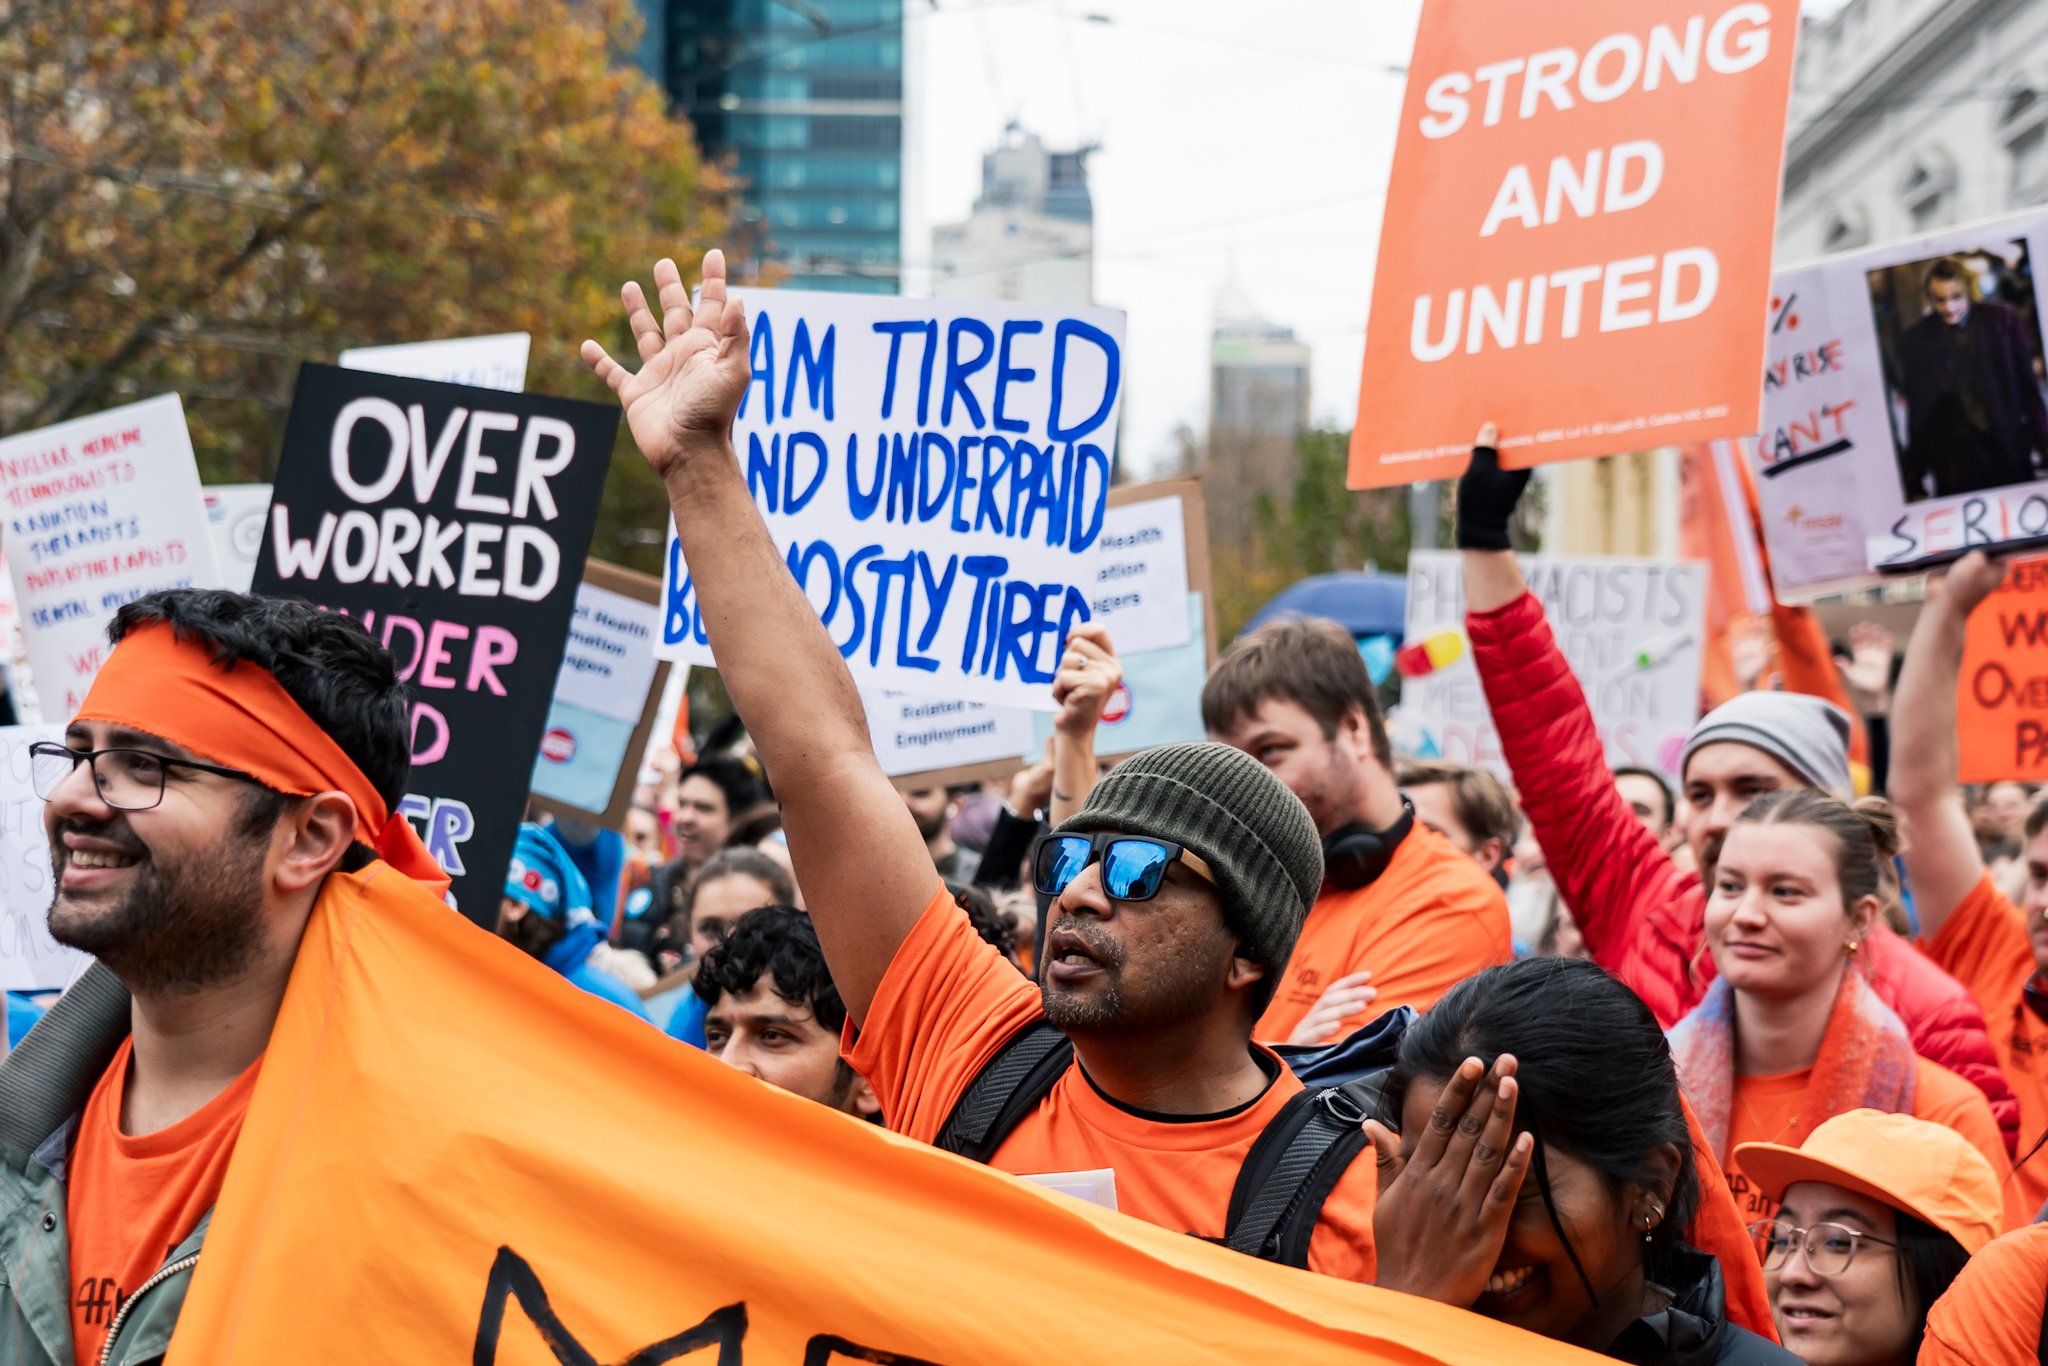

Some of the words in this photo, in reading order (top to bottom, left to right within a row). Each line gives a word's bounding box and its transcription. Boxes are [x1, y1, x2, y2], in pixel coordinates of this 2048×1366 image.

[1419, 2, 1771, 139] STRONG
[1479, 140, 1664, 237] AND
[1410, 246, 1719, 362] UNITED
[738, 310, 835, 425] AM
[873, 317, 1121, 441] TIRED
[1765, 358, 1788, 391] AY
[1793, 338, 1844, 381] RISE
[82, 426, 145, 457] MEDICINE
[330, 397, 576, 520] OVER
[1758, 400, 1856, 463] CAN'T
[748, 431, 829, 515] ND
[847, 432, 1110, 554] UNDERPAID
[28, 515, 141, 562] THERAPISTS
[272, 503, 560, 601] WORKED
[1100, 526, 1163, 553] Health
[1097, 561, 1147, 583] ation
[31, 597, 93, 630] DENTAL
[594, 610, 651, 640] Health
[787, 540, 957, 673] OSTLY
[319, 606, 519, 697] DER
[566, 653, 612, 679] agers
[896, 719, 997, 749] Employment
